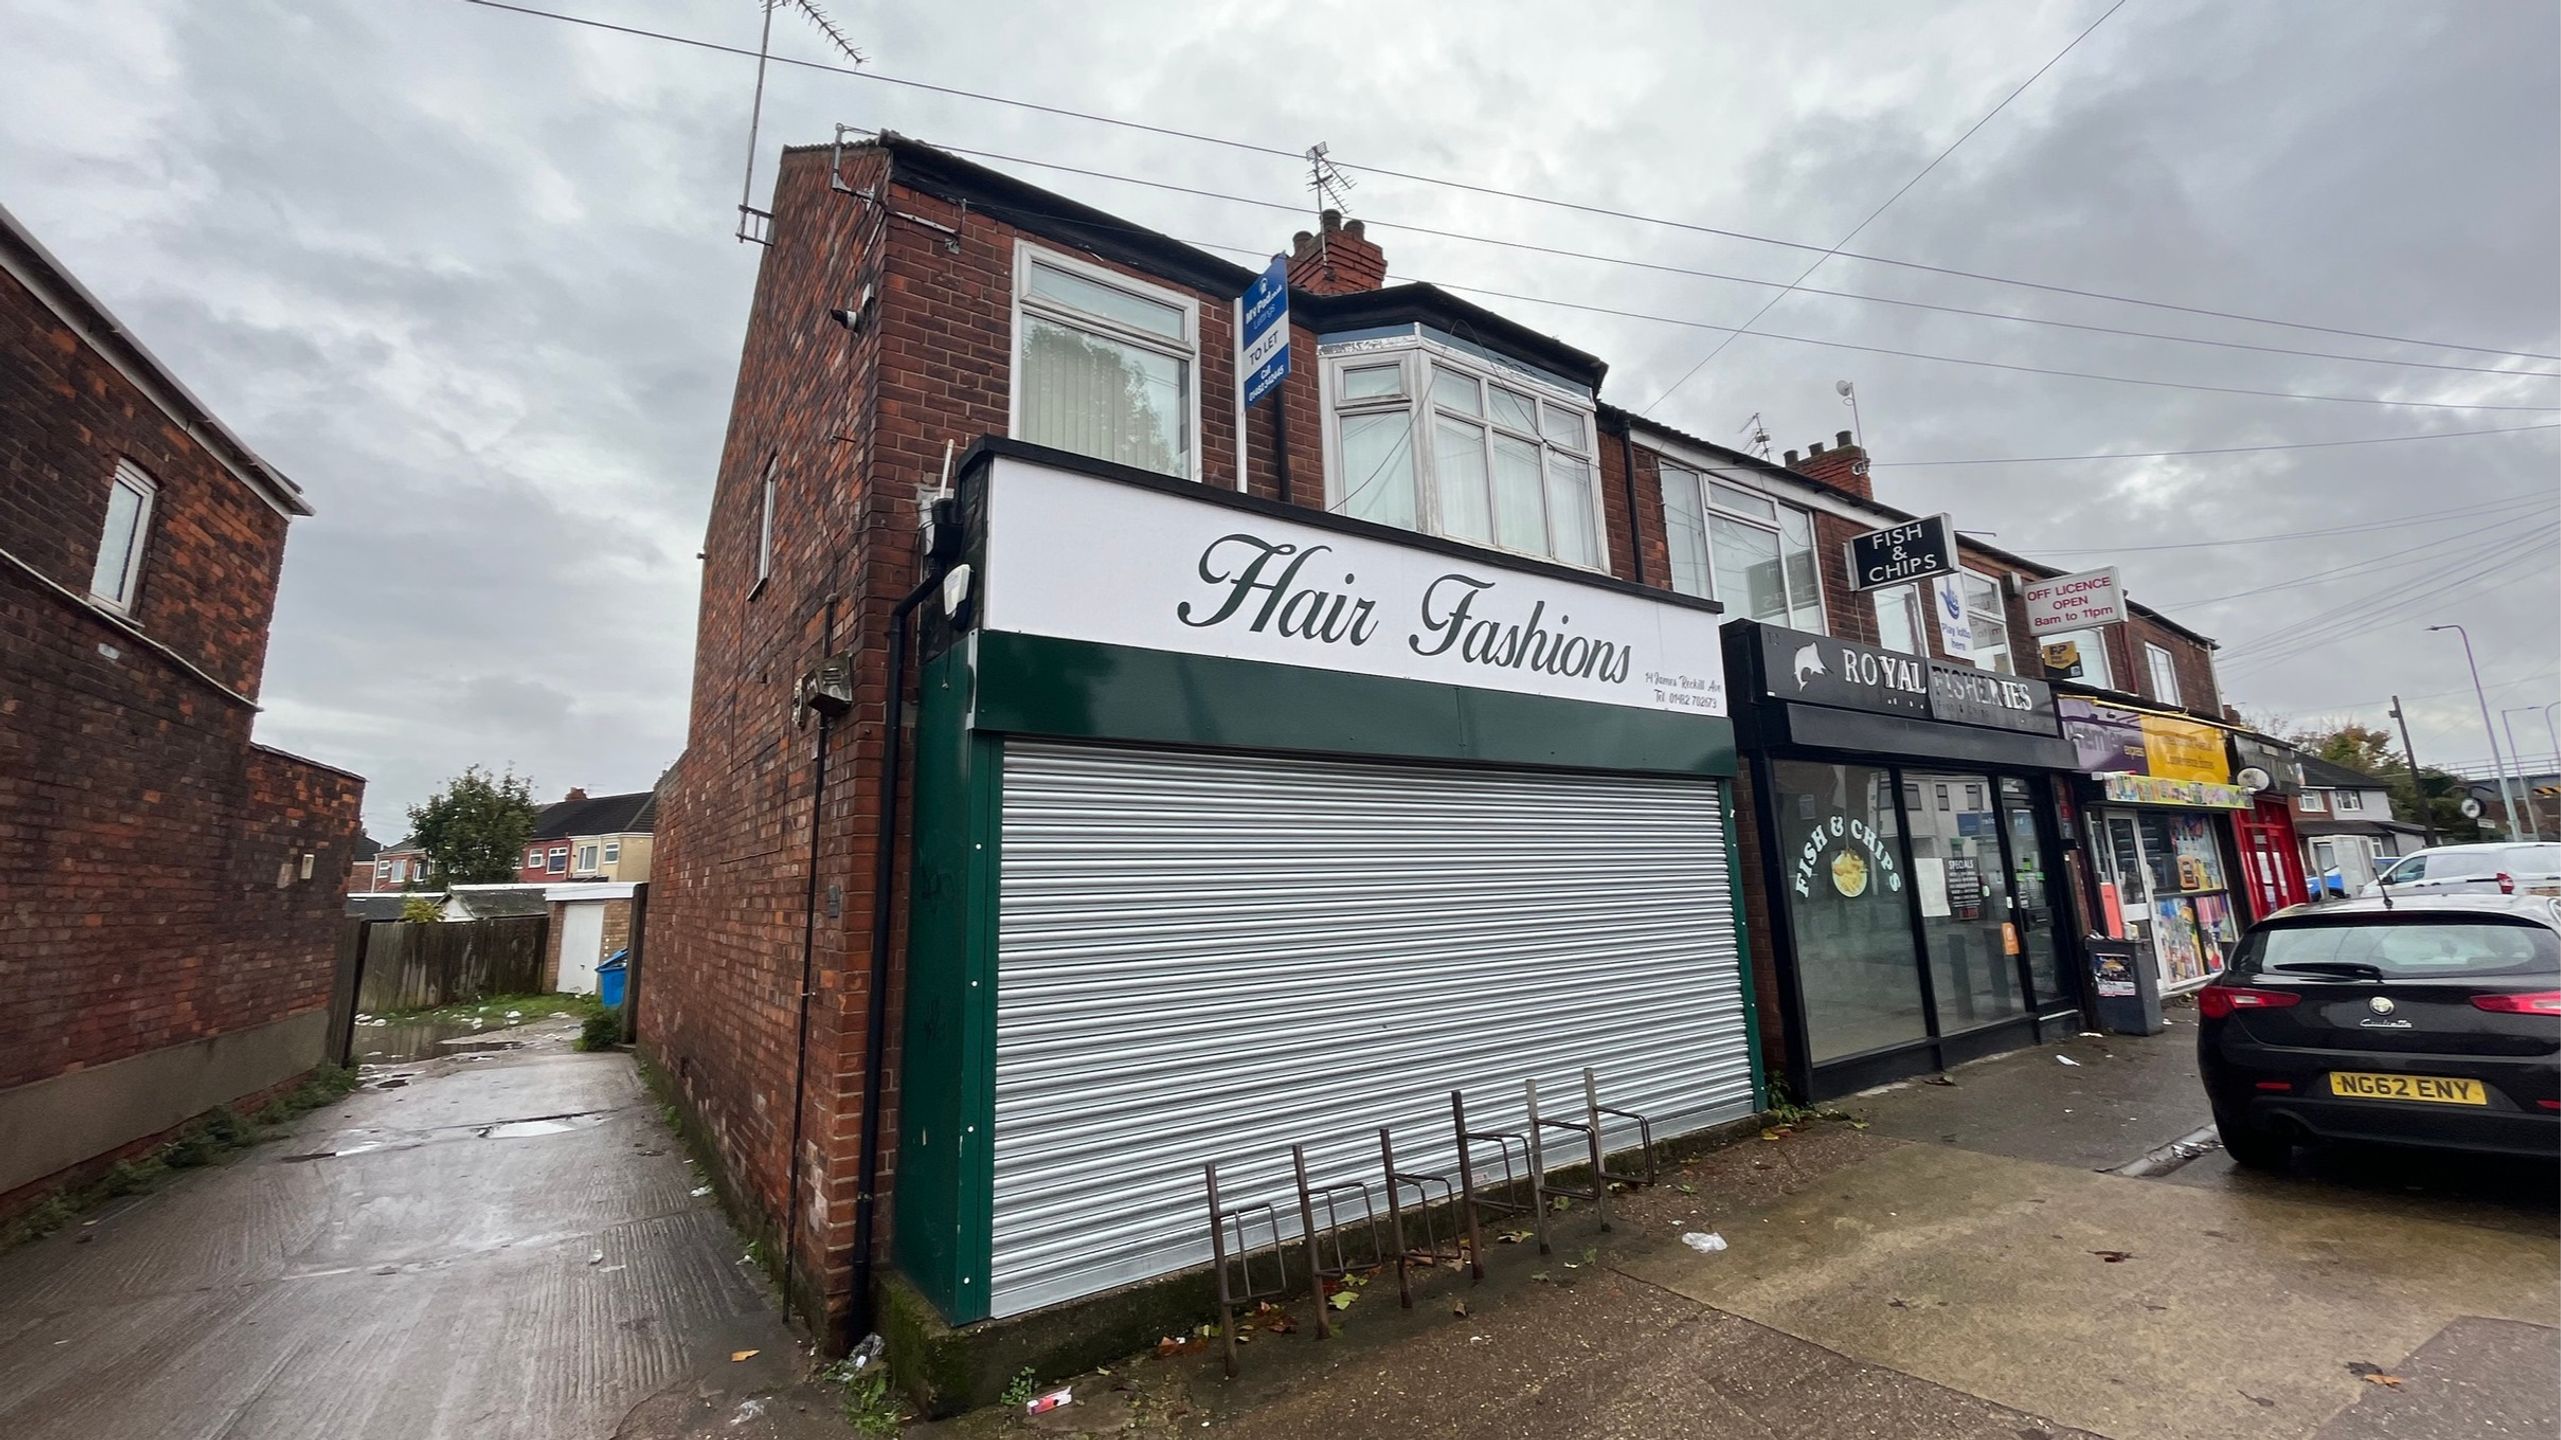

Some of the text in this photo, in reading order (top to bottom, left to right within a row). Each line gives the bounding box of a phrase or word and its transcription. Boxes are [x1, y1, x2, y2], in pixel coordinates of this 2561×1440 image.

[1249, 330, 1279, 365] TO LET
[1872, 523, 1924, 550] FISH
[1892, 546, 1908, 562] &
[1868, 553, 1938, 583] CHIPS
[2027, 576, 2111, 602] OFF LICENCE
[1177, 533, 1380, 647] Hair
[1408, 573, 1632, 684] Fashions
[2052, 595, 2089, 611] OPEN
[2034, 605, 2114, 628] 8am to 11pm
[1653, 671, 1677, 687] James
[1842, 648, 2033, 711] ROYAL FISHERIES
[1795, 824, 1829, 898] FISH
[1830, 815, 1845, 838] &
[1850, 820, 1902, 893] CHIPS
[1948, 859, 1975, 870] SPECIALS
[2340, 1075, 2471, 1100] NG62 ENY
